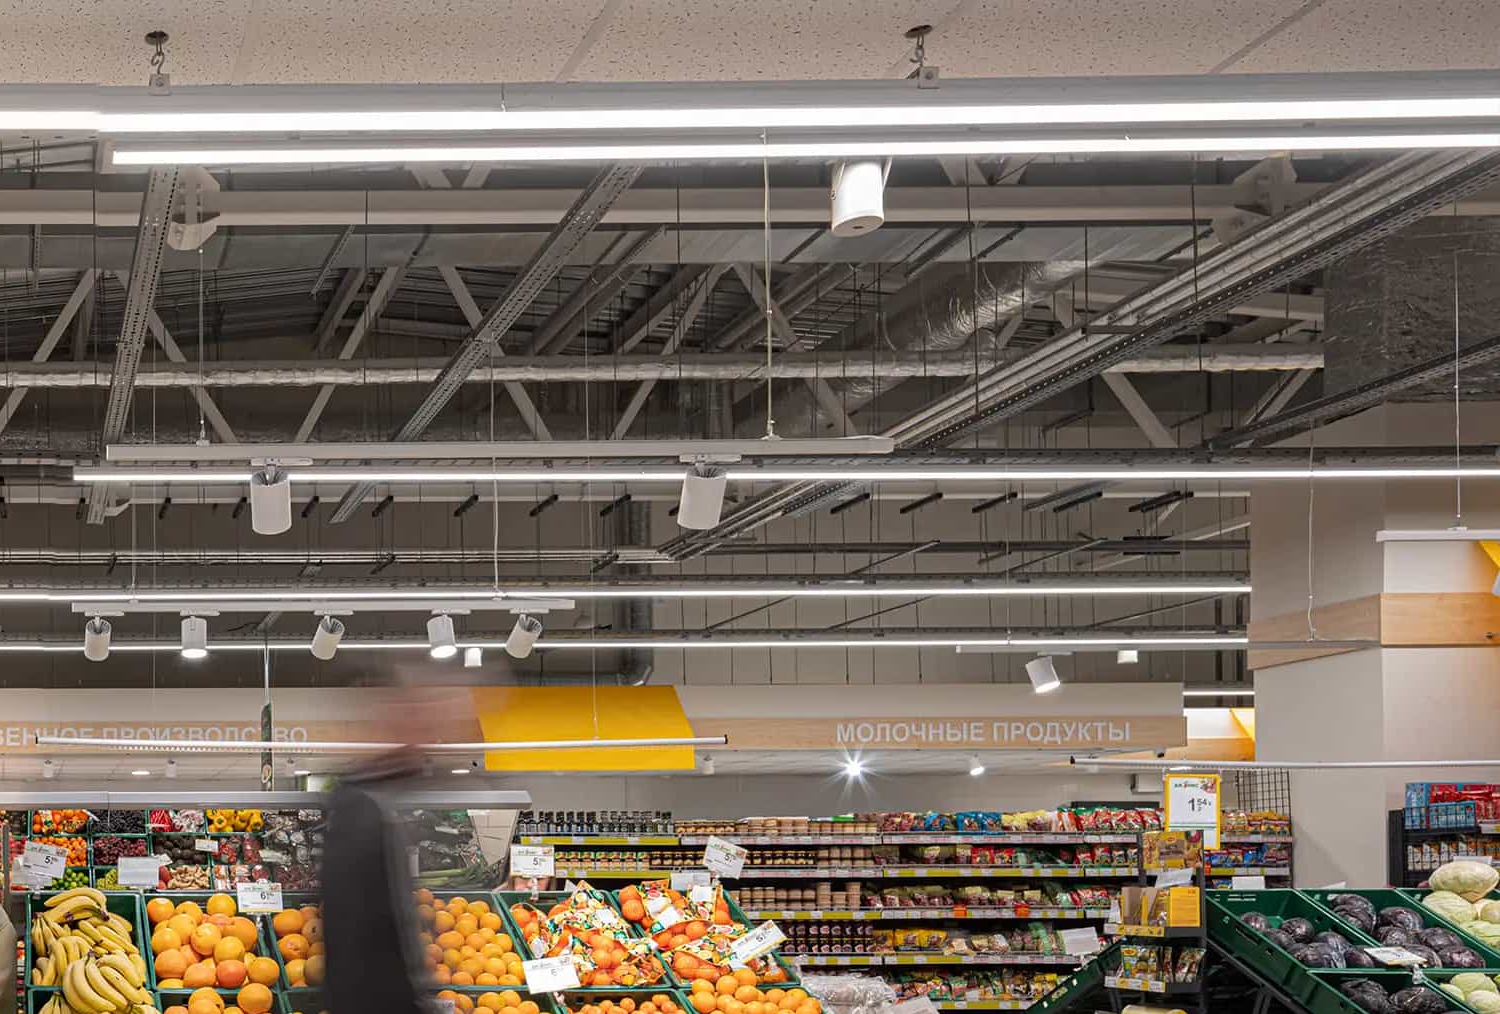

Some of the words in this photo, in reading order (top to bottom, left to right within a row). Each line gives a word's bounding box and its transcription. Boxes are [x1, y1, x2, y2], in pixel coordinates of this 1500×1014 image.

[102, 727, 308, 744] ПРОИЗВОДСВО
[836, 722, 984, 743] МОЛОЧНЫЕ
[991, 722, 1130, 744] ПРОДУКТЫ
